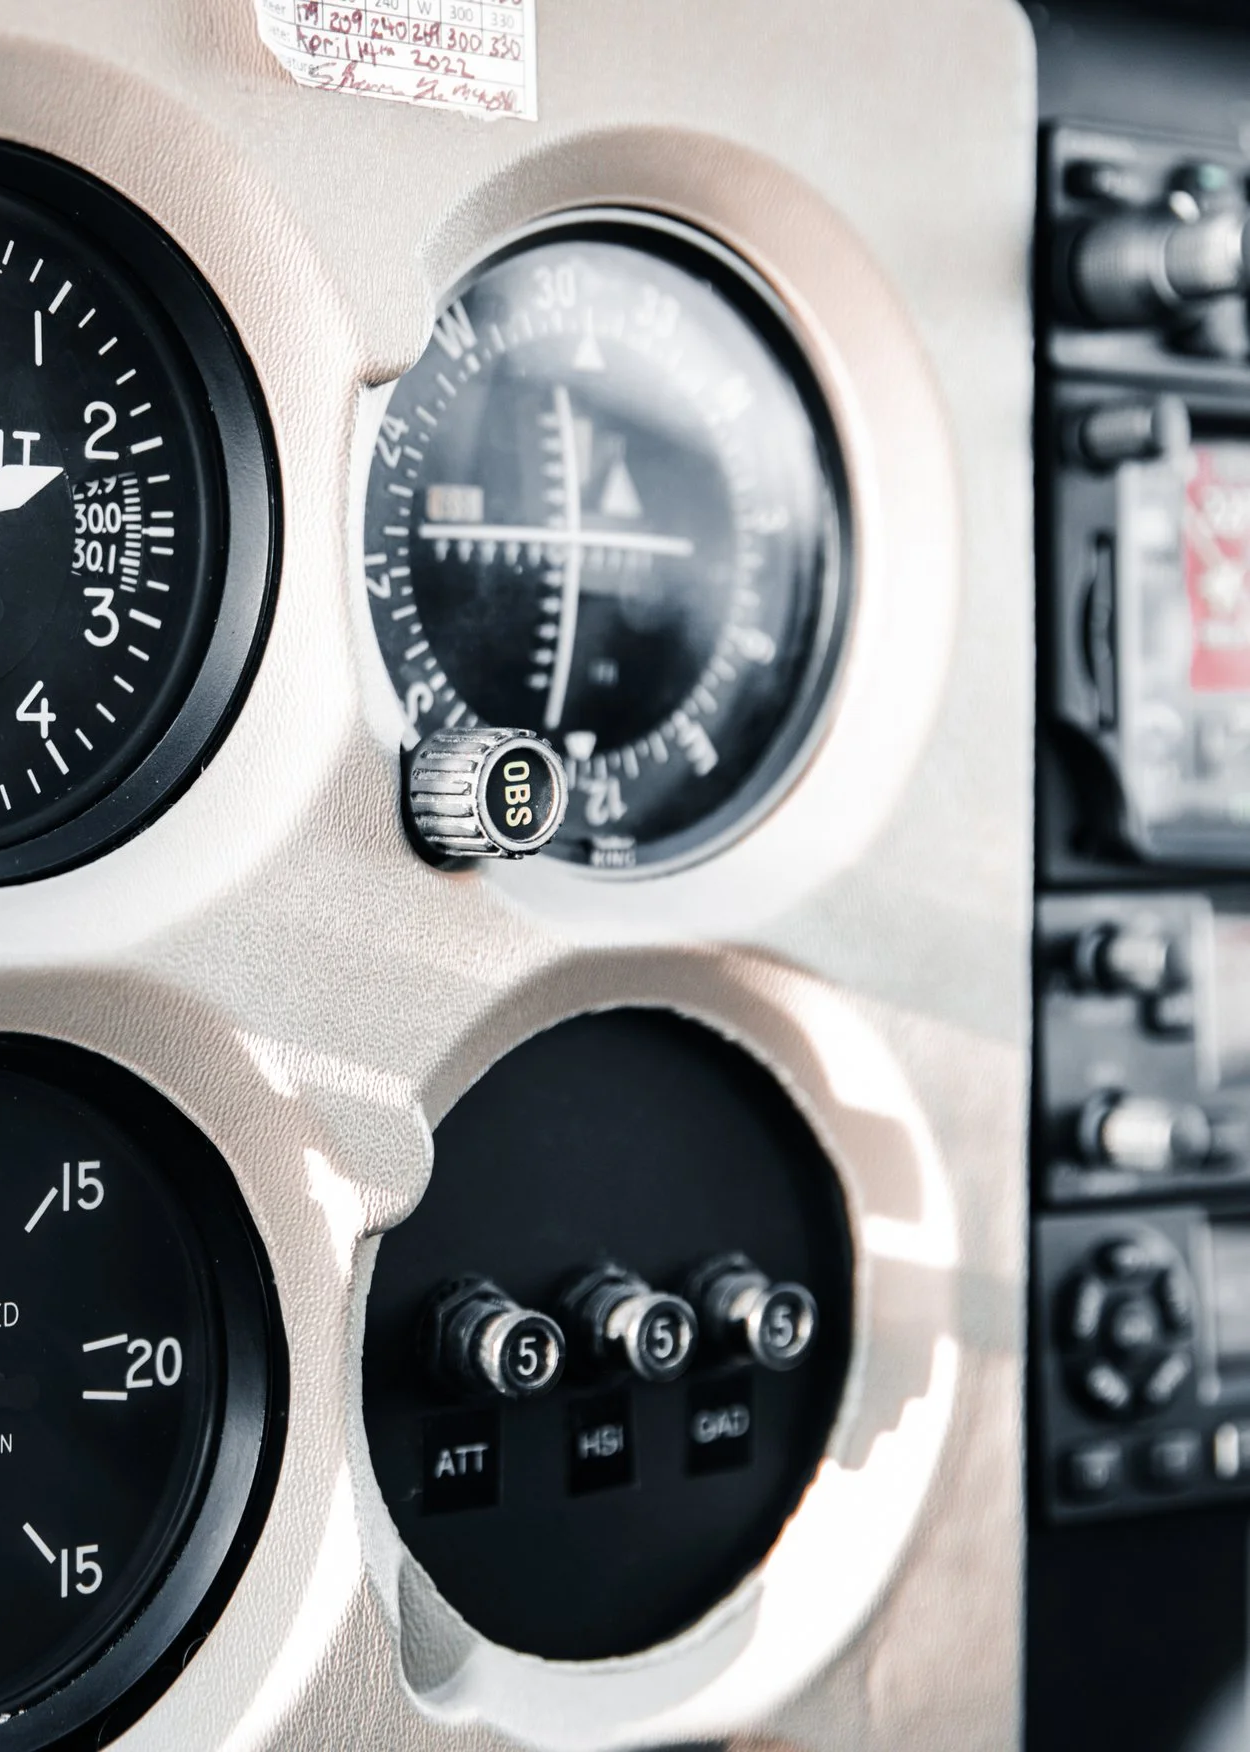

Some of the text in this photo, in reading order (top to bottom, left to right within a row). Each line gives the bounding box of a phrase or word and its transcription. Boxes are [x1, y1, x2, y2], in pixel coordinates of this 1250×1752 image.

[330, 8, 363, 35] 209
[370, 16, 407, 41] 240
[447, 28, 482, 52] 300
[489, 33, 521, 61] 330
[450, 5, 474, 22] 300
[491, 12, 516, 29] 330
[410, 49, 474, 80] 2022
[534, 263, 576, 310] 30
[432, 299, 478, 361] W
[83, 400, 119, 461] 2
[74, 502, 121, 534] 30.0
[71, 538, 116, 575] 30.1
[83, 586, 119, 648] 3
[16, 680, 56, 739] 4
[503, 759, 534, 828] OBS
[62, 1160, 105, 1212] 15
[654, 1316, 675, 1360] 5
[768, 1305, 793, 1348] 5
[126, 1336, 183, 1389] 20
[518, 1337, 538, 1377] 5
[435, 1443, 489, 1478] ATT
[580, 1426, 624, 1458] HSI
[60, 1544, 103, 1599] 15
